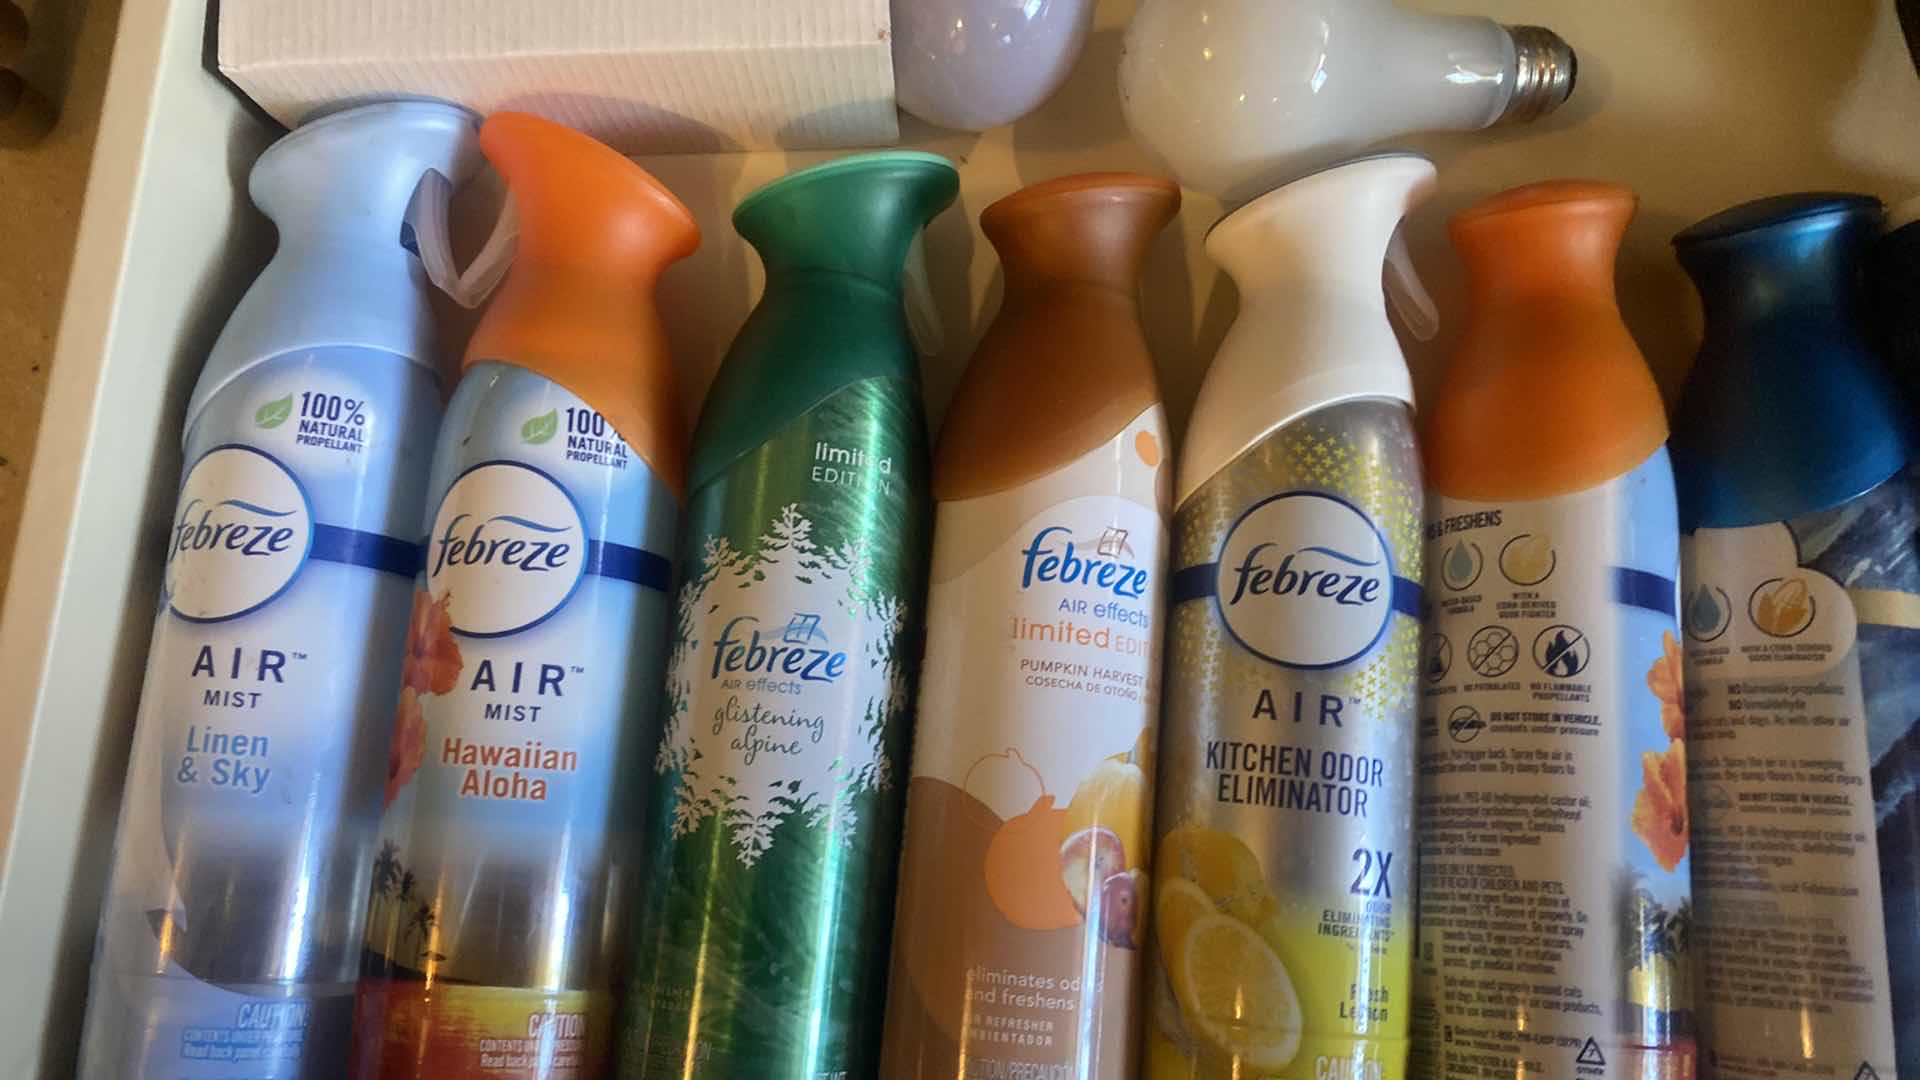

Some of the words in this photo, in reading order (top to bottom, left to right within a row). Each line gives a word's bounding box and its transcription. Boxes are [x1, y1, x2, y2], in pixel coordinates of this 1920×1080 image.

[299, 390, 366, 427] 100%
[296, 433, 363, 454] PROPELLANT
[298, 418, 365, 443] NATURAL
[566, 449, 628, 469] PROPELLANT
[567, 435, 629, 459] NATURAL
[815, 442, 892, 476] limited
[169, 499, 294, 563] febreze
[1444, 509, 1503, 534] FRESHENS
[431, 513, 572, 577] febreze
[1021, 526, 1149, 600] febreze
[1230, 542, 1381, 607] febreze
[1058, 598, 1089, 616] AIR
[1093, 602, 1150, 629] effects
[1012, 616, 1111, 650] limited
[192, 645, 287, 684] AIR
[711, 615, 848, 684] febreze
[470, 660, 566, 698] AIR
[720, 679, 744, 690] AIR
[745, 677, 804, 696] effects
[1020, 658, 1088, 677] PUMPKIN
[1092, 667, 1144, 687] HARVEST
[1025, 675, 1083, 691] COSECHA
[1086, 682, 1101, 694] DE
[203, 690, 262, 709] MIST
[485, 703, 542, 723] MIST
[1252, 689, 1344, 728] AIR
[712, 695, 826, 742] glistening
[185, 725, 270, 758] Linen
[442, 737, 579, 771] Hawaiian
[730, 723, 804, 766] alpine
[177, 757, 199, 784] &
[211, 759, 271, 795] Sky
[1205, 740, 1312, 779] KITCHEN
[1320, 752, 1385, 788] ODOR
[459, 772, 548, 801] Aloha
[1217, 774, 1369, 819] ELIMINATOR
[1350, 848, 1394, 898] 2X
[1322, 909, 1392, 930] ELIMIATING
[965, 967, 1056, 990] eliminates
[1351, 984, 1389, 1003] Fsh
[1001, 990, 1076, 1011] freshens
[528, 1013, 586, 1039] CATION
[964, 1027, 1054, 1047] MBIENTADOR
[1315, 1055, 1383, 1080] CAUION
